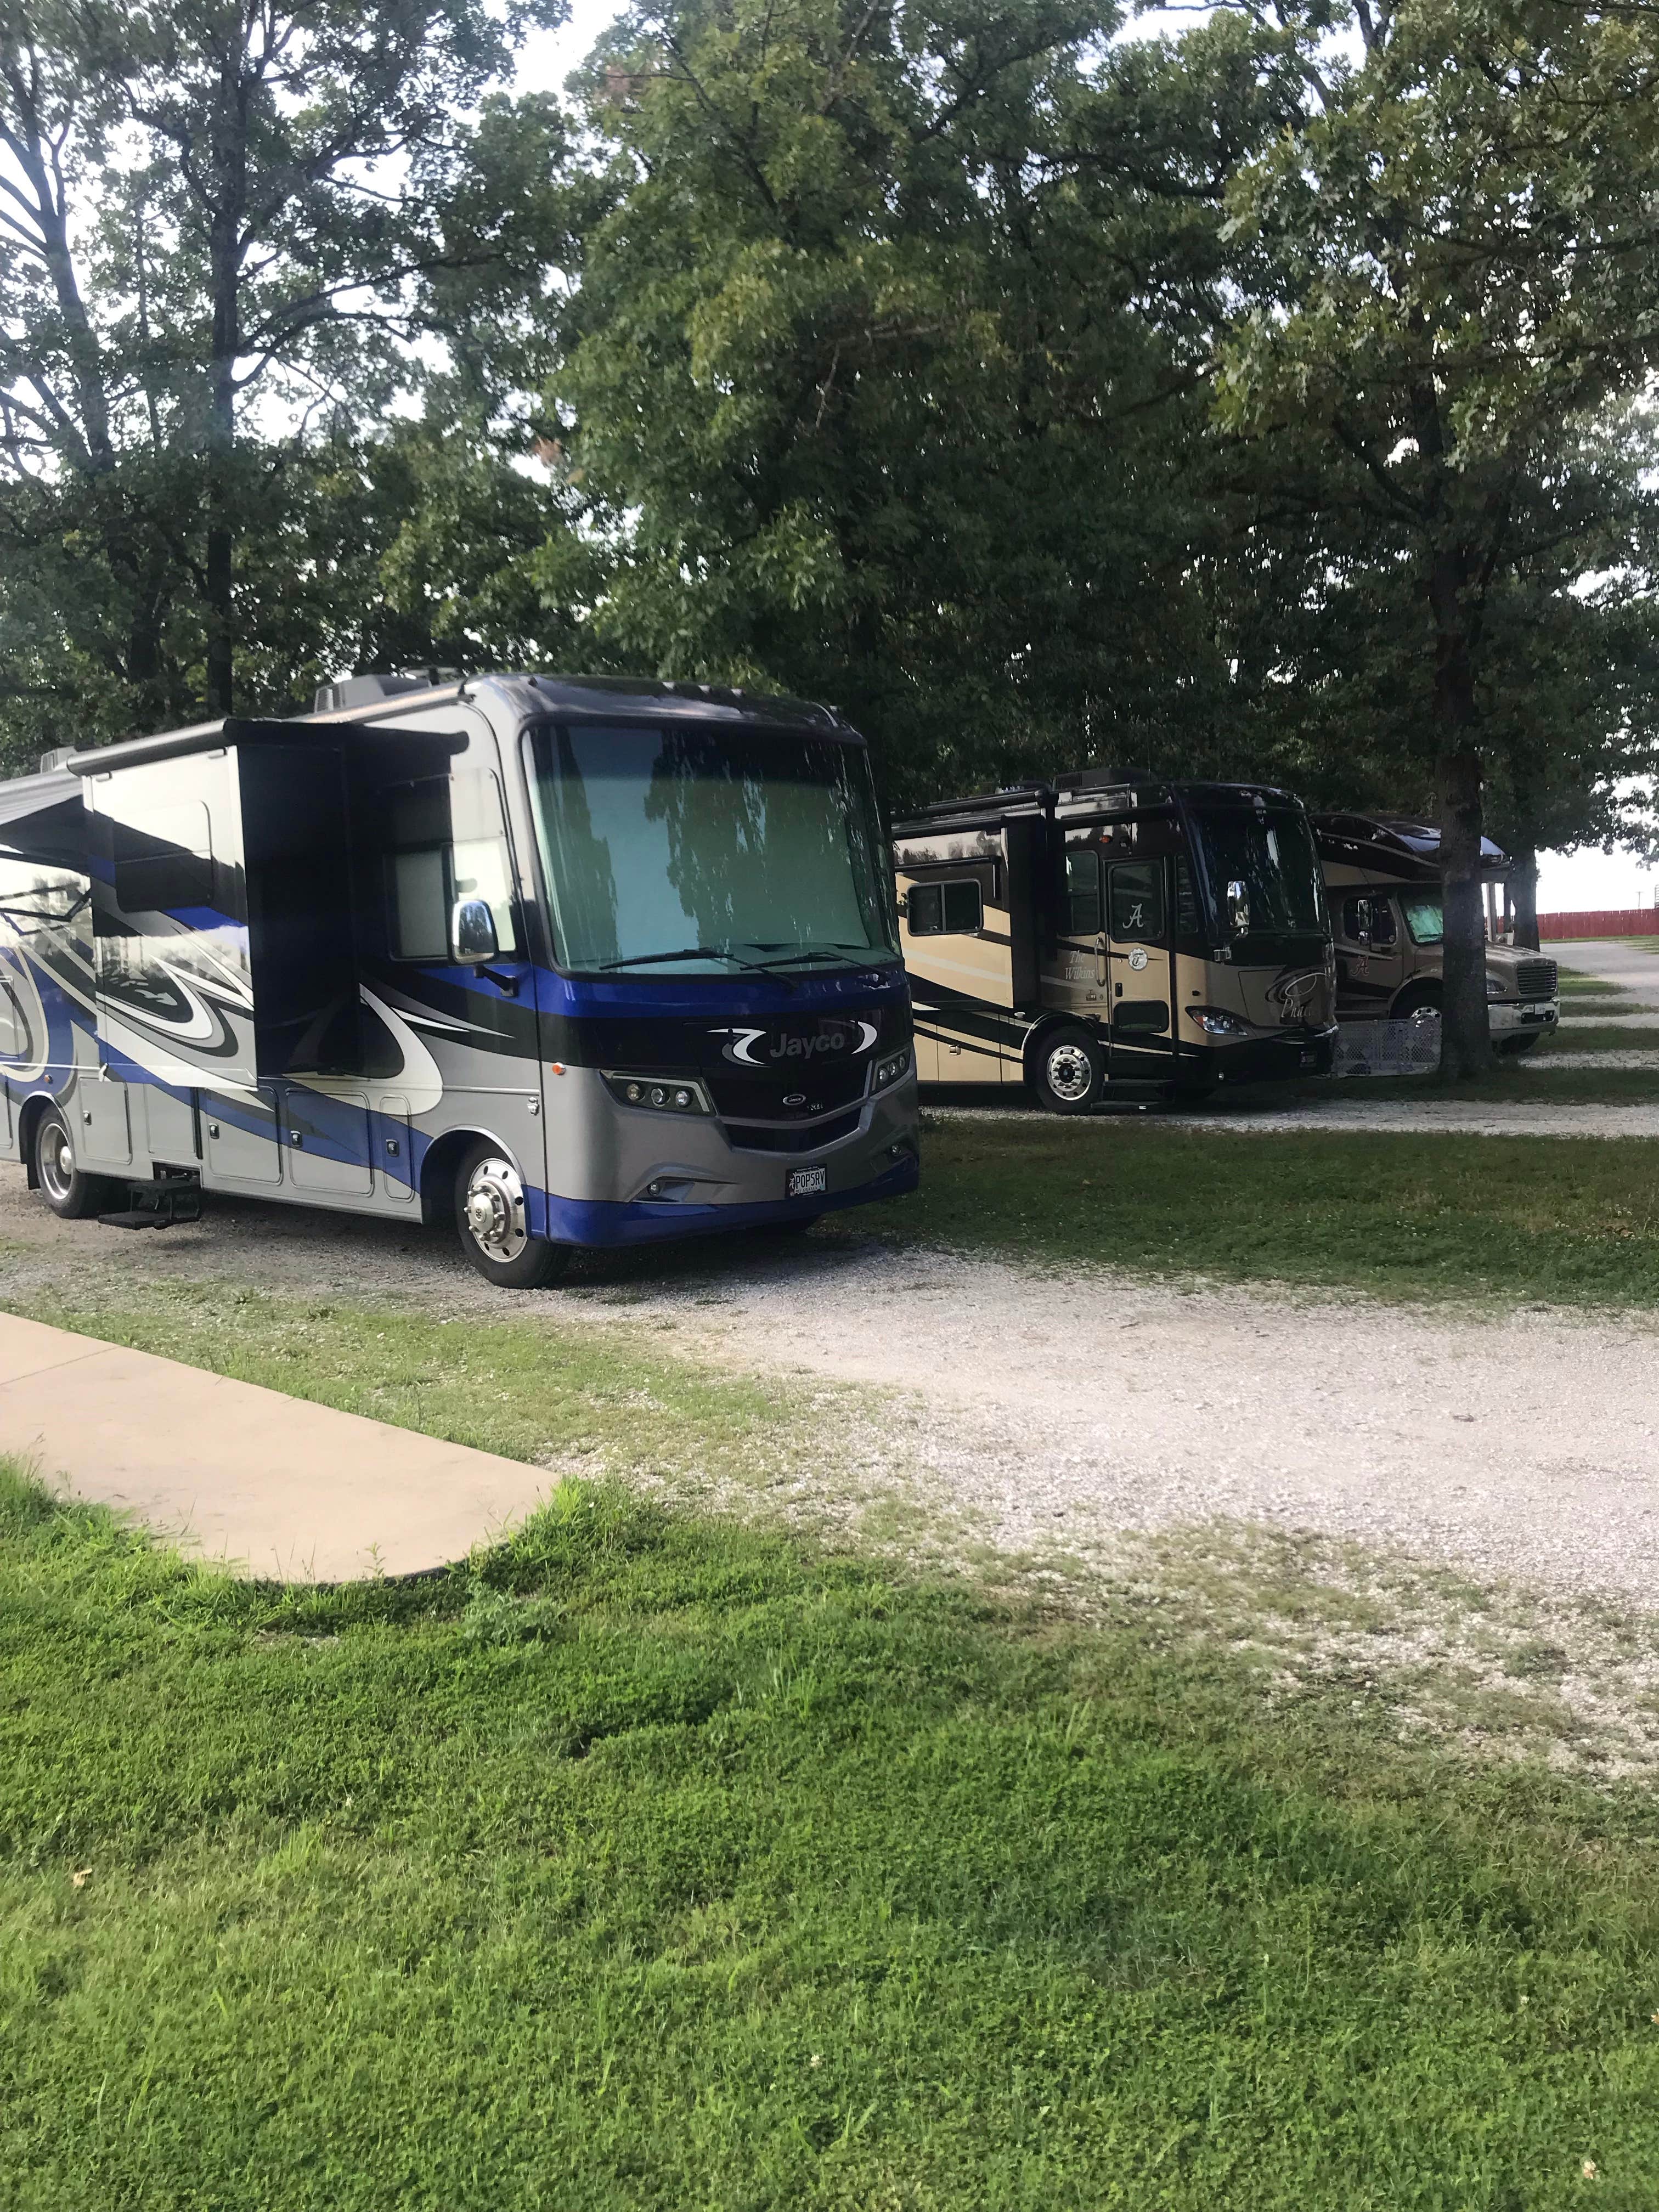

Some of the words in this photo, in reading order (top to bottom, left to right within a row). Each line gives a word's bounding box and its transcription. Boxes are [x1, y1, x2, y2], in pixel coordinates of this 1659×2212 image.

[1070, 950, 1086, 963] The
[1065, 967, 1096, 980] Wilkins
[770, 1032, 845, 1059] Jayco
[795, 1171, 825, 1189] POPSRV
